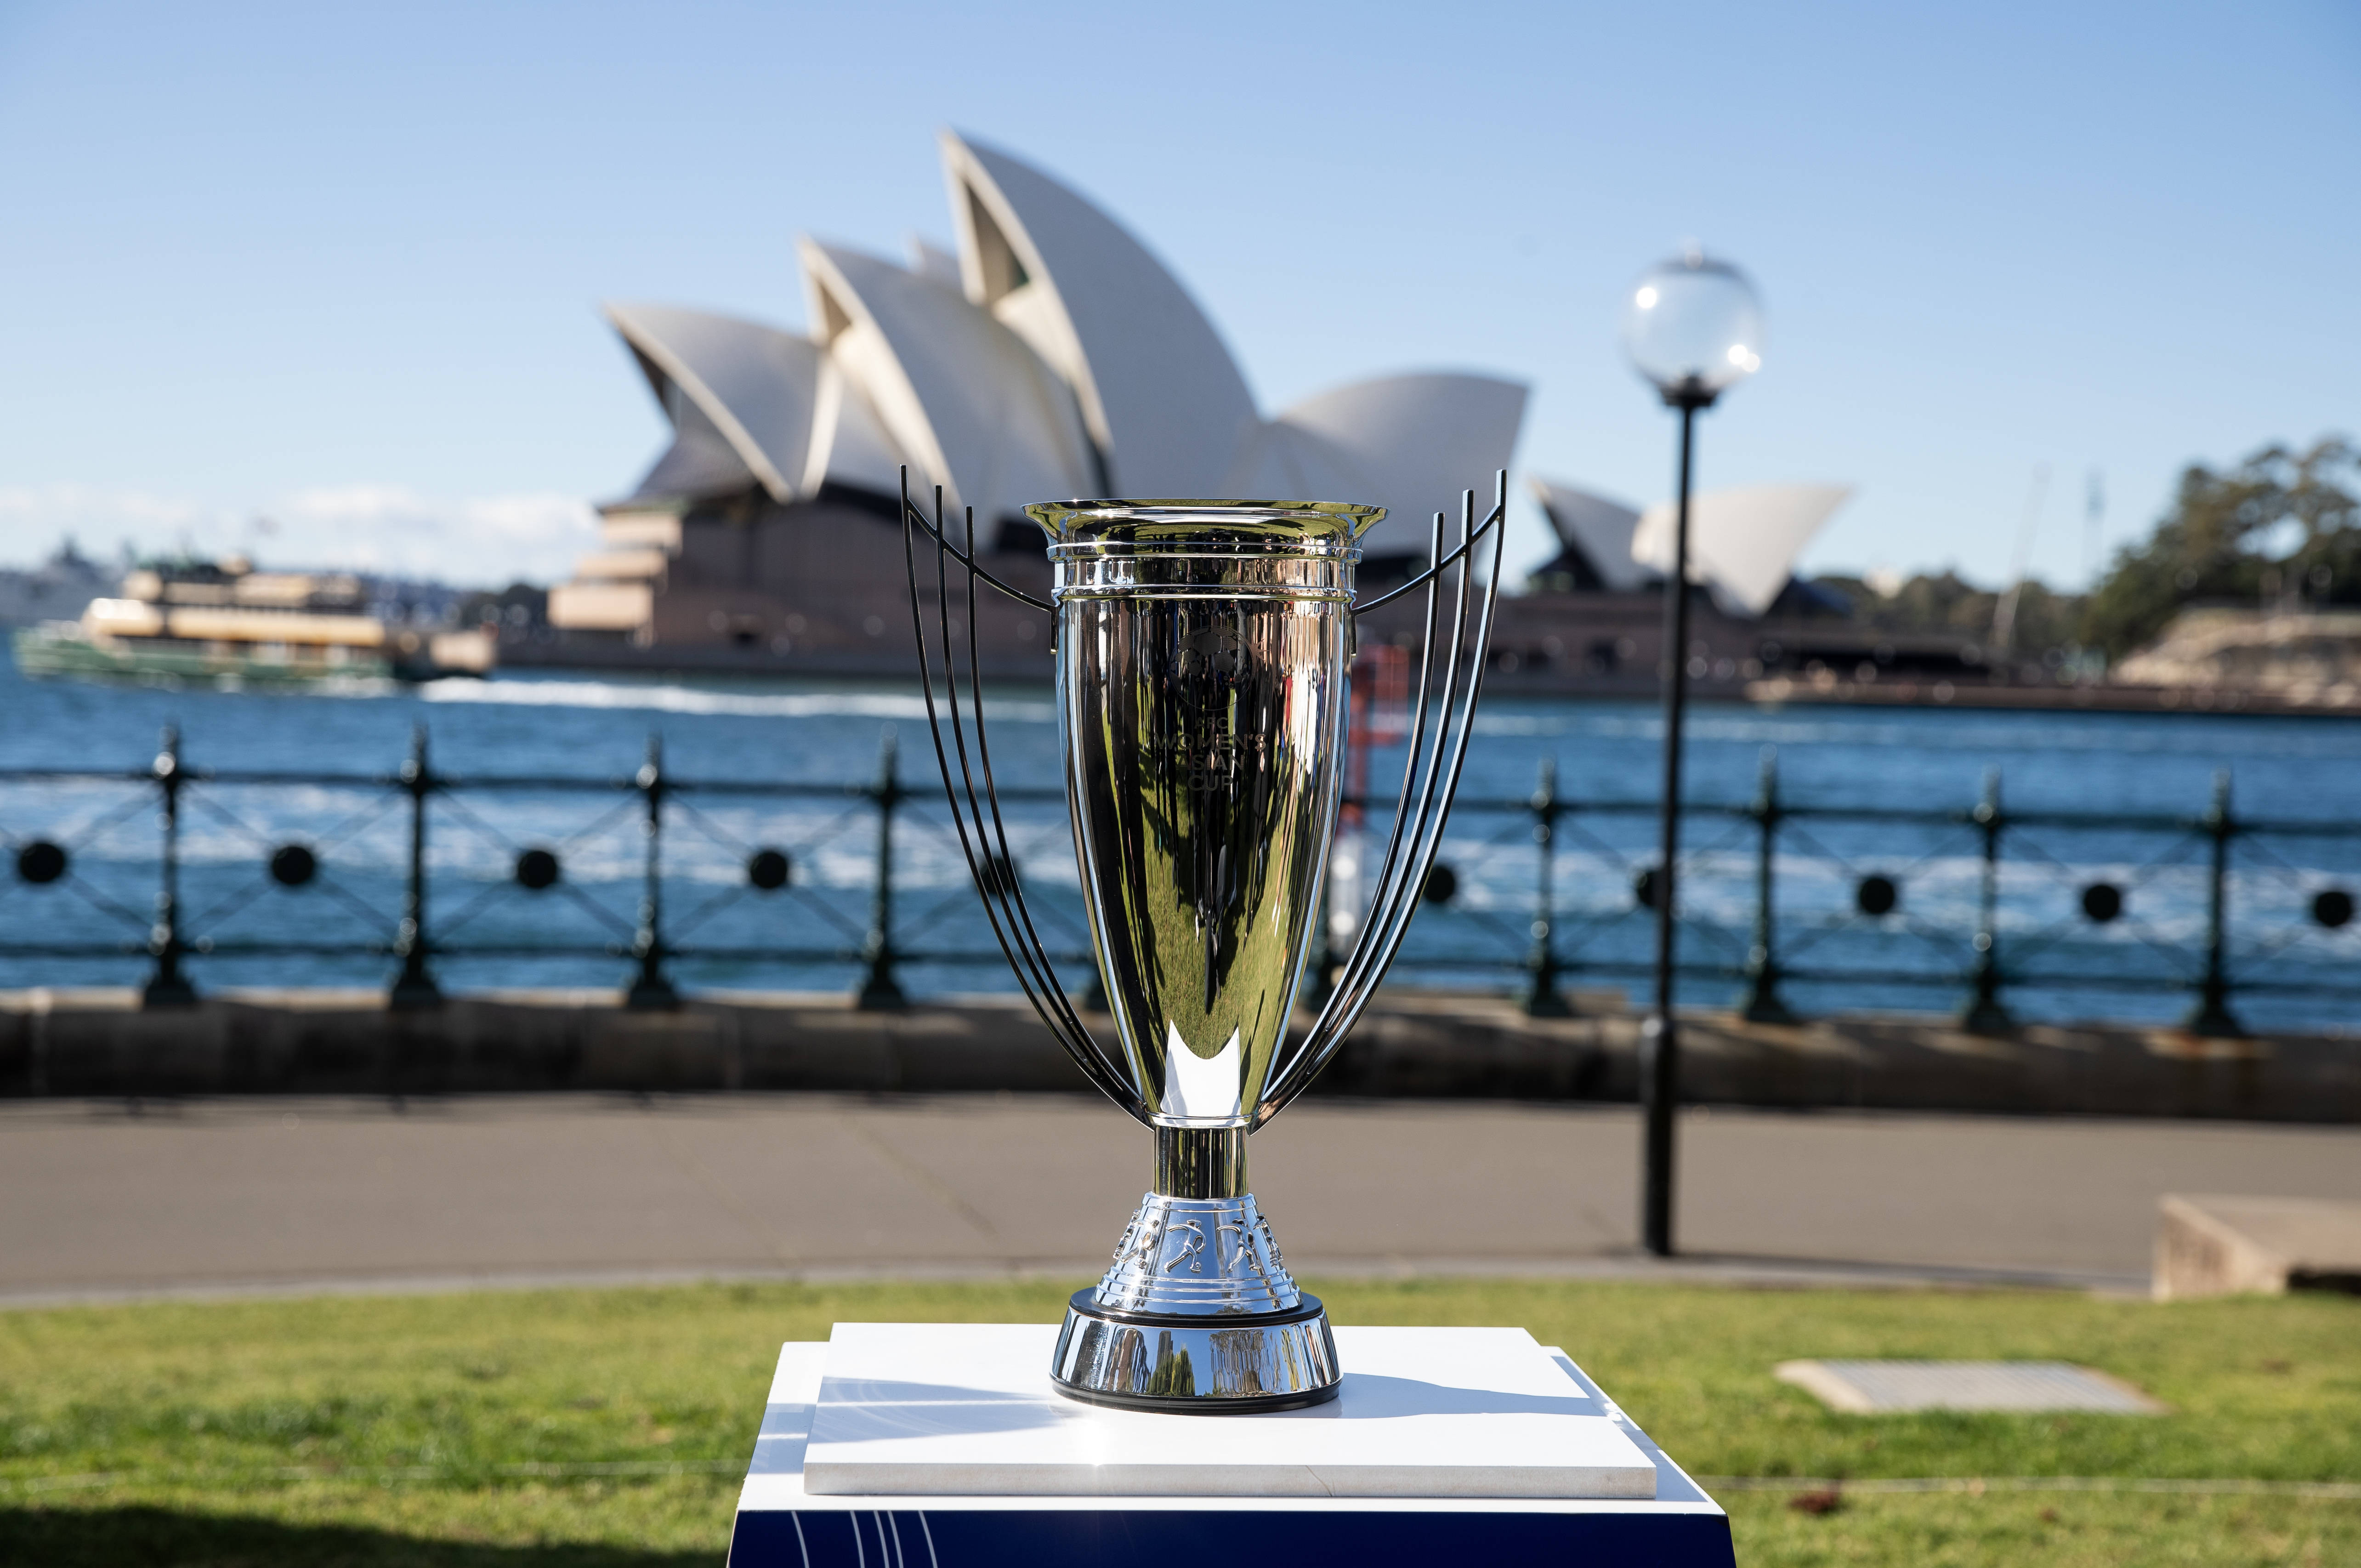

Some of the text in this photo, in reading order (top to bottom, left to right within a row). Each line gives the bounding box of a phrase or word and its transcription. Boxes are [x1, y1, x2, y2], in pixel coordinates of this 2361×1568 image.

[1194, 717, 1228, 729] AFC
[1155, 733, 1266, 750] WOMEN'S
[1176, 755, 1244, 770] ASIAN
[1188, 775, 1233, 791] CUP
